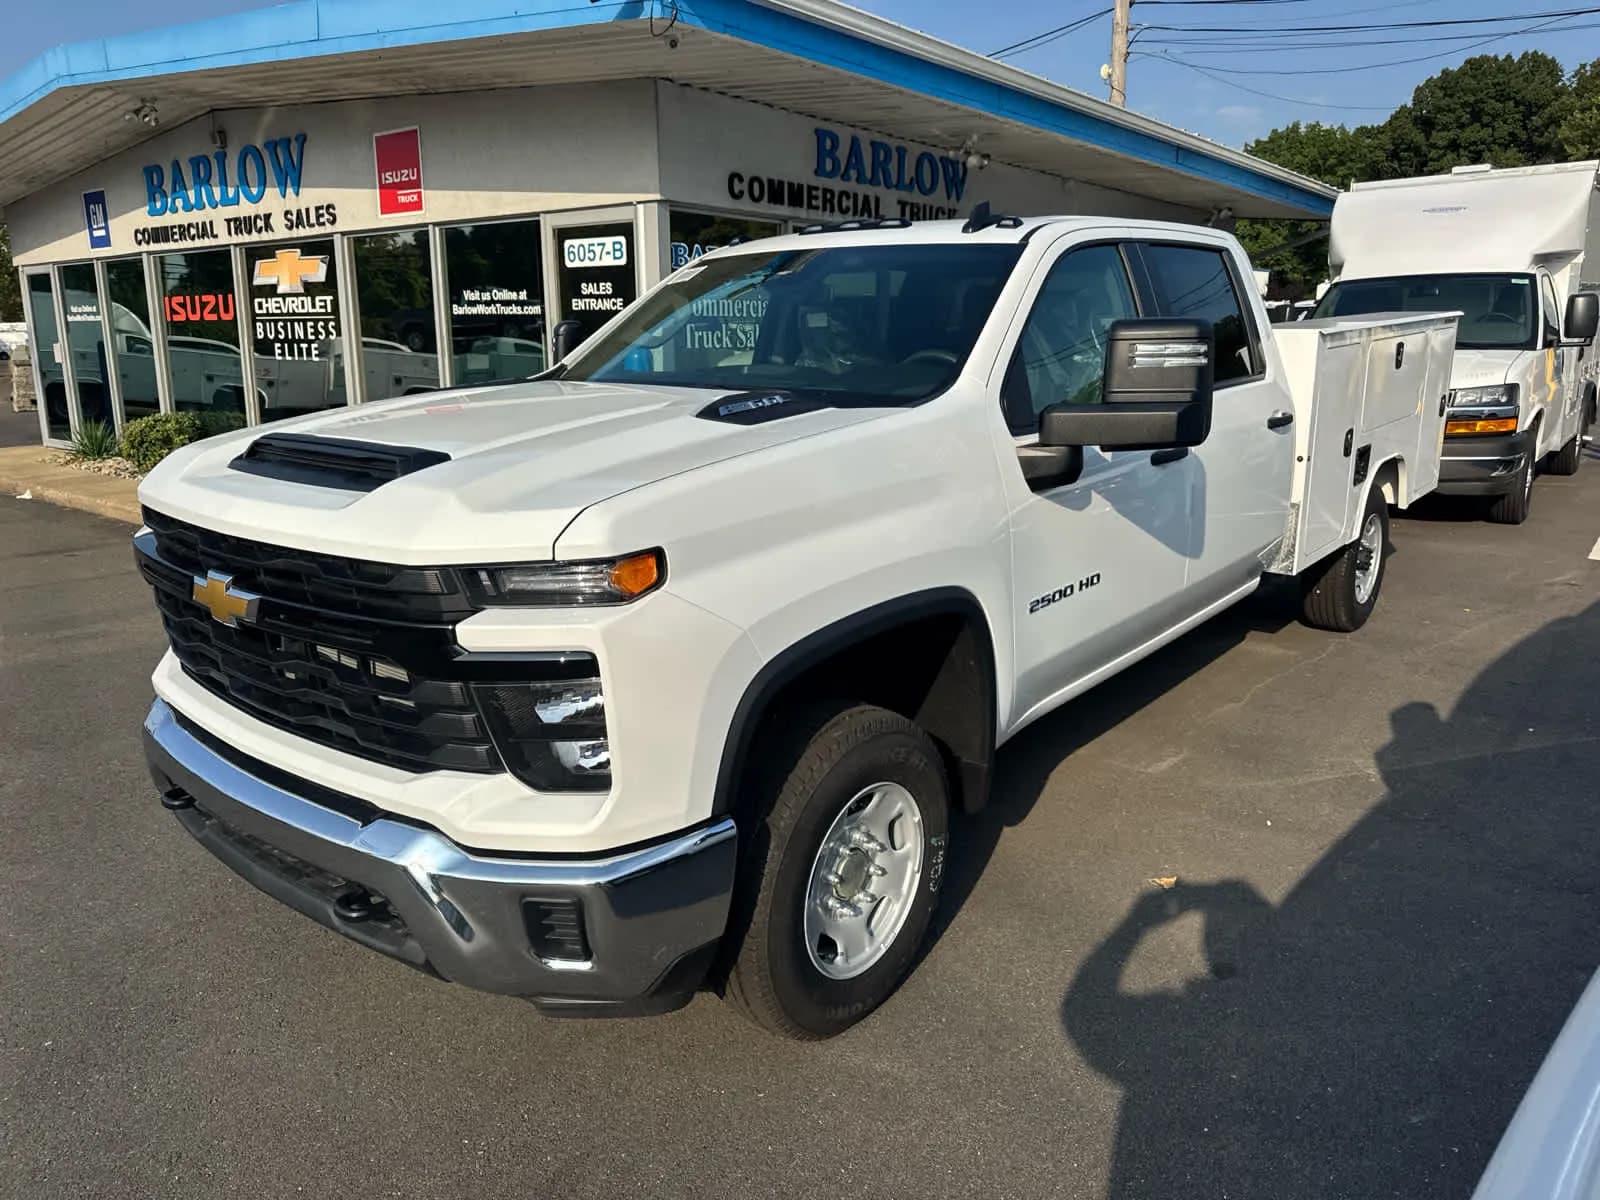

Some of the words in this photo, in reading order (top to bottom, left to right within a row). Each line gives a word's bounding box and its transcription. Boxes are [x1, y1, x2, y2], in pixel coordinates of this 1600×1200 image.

[143, 131, 307, 216] BARLOW
[814, 128, 968, 202] BARLOW
[381, 167, 418, 184] ISUZU
[397, 193, 419, 204] TRUCK
[728, 172, 884, 219] COMMERCIAL
[89, 203, 105, 229] GM
[134, 219, 218, 246] COMMERCIAL
[224, 212, 274, 237] TRUCK
[283, 203, 337, 231] SALES
[567, 240, 624, 263] 6057-B
[463, 288, 480, 301] Visit
[481, 292, 491, 301] us
[492, 288, 517, 301] Online
[519, 289, 527, 300] at
[580, 282, 613, 295] SALES
[163, 294, 235, 321] ISUZU
[254, 296, 333, 313] CHEVROLET
[452, 303, 542, 315] BarlowWorkTrucks.com
[571, 298, 624, 311] ENTRANCE
[255, 321, 337, 340] BUSINESS
[274, 343, 320, 361] ELITE
[1029, 583, 1074, 614] 2500
[1079, 572, 1101, 592] HD
